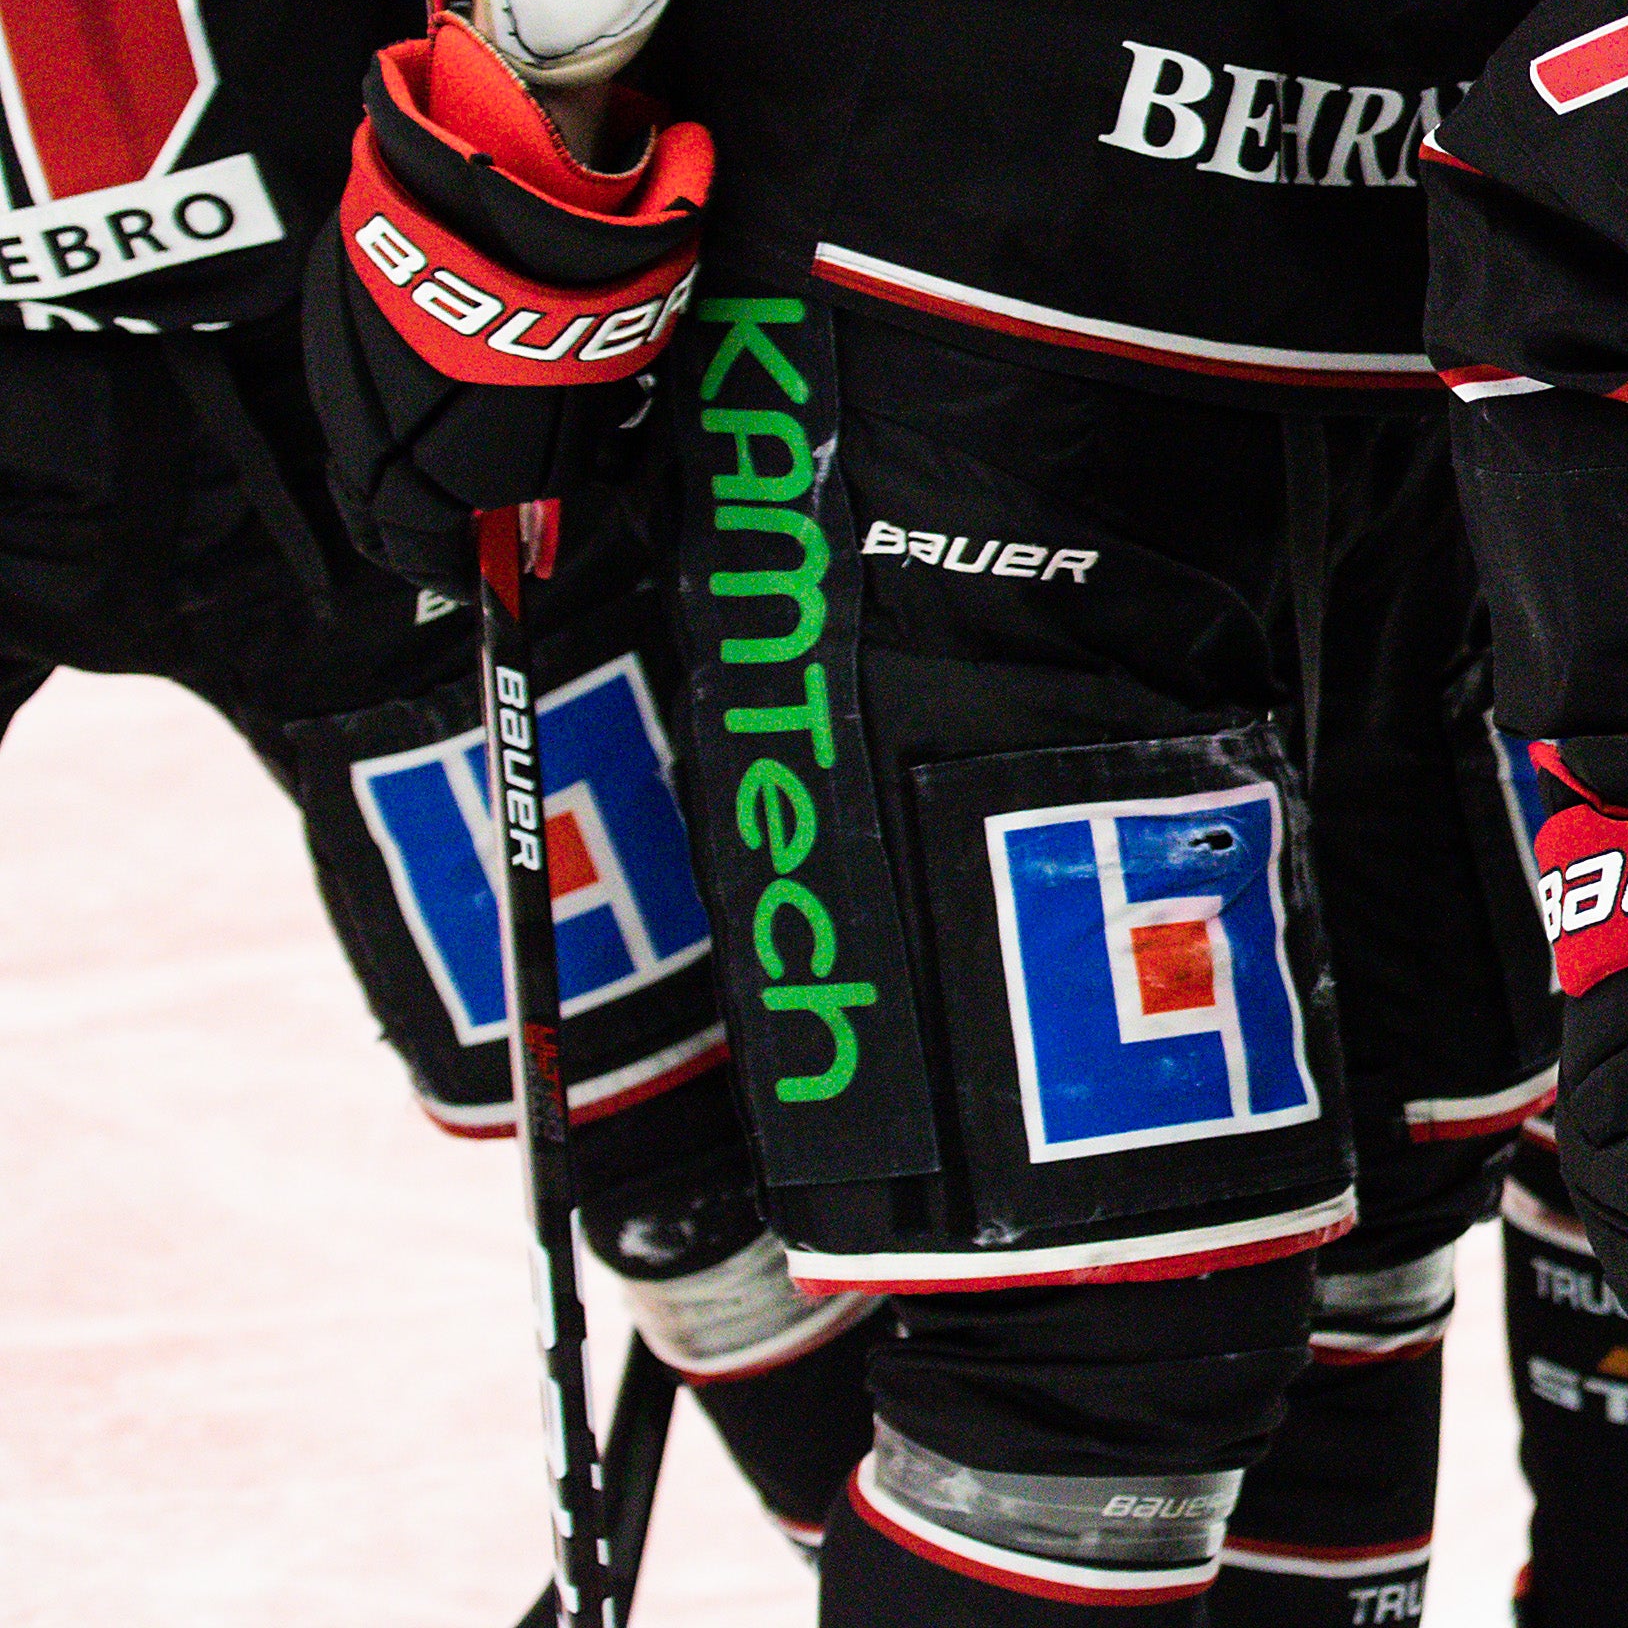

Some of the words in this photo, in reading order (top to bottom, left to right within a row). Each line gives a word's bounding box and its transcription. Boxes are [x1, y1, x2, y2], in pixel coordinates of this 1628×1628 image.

[354, 212, 700, 364] BAUER
[861, 520, 1102, 584] BAUER
[494, 664, 543, 873] BAUER
